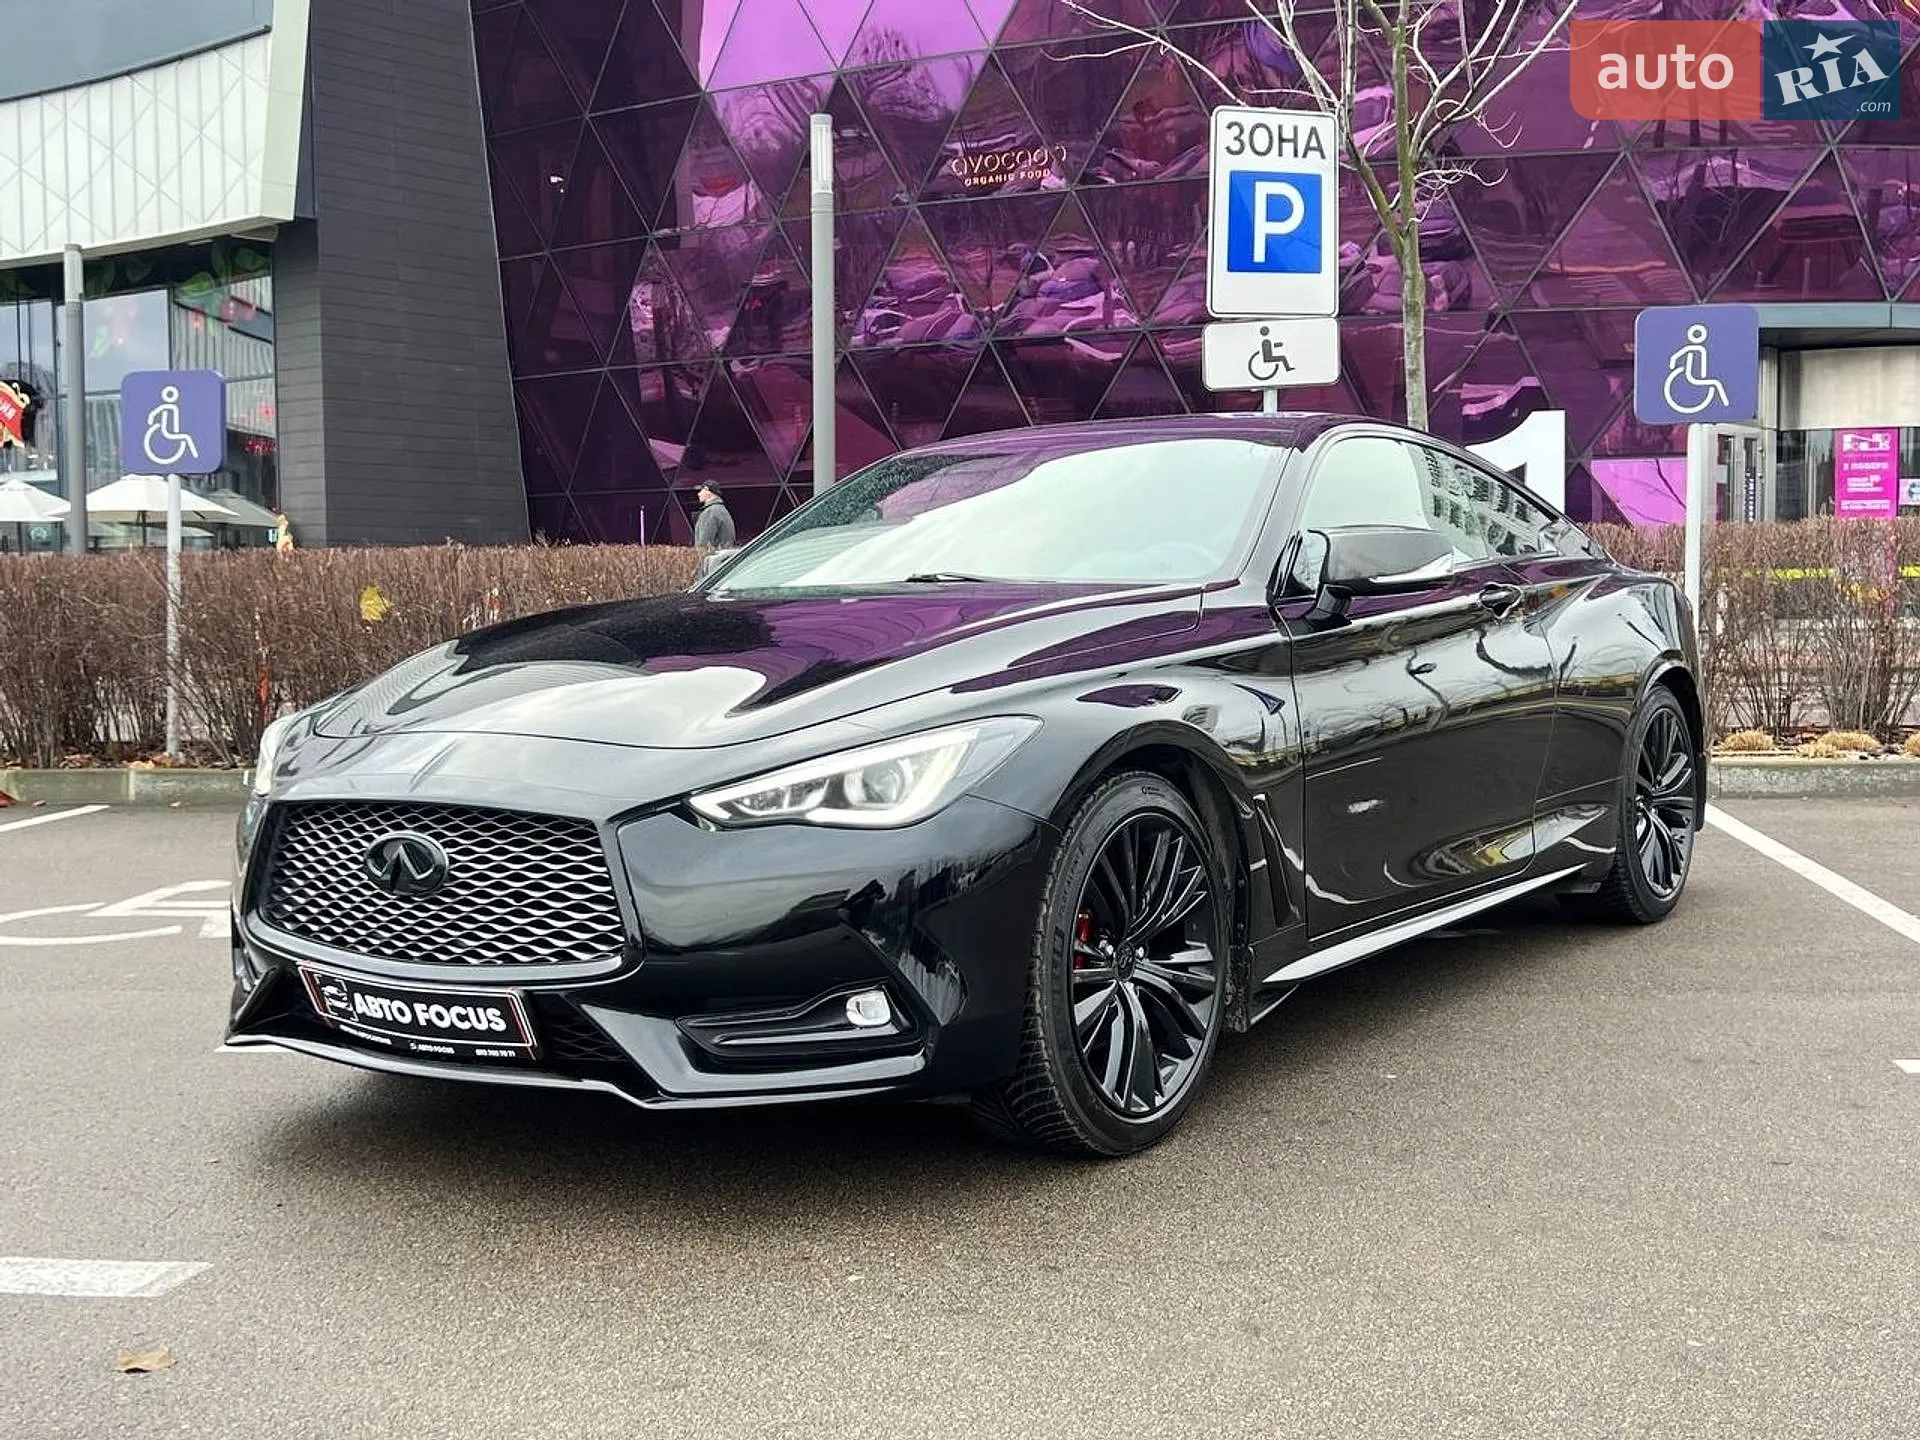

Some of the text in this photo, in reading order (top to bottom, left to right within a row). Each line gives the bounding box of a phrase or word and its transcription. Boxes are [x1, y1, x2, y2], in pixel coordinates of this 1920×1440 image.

[1225, 121, 1326, 160] ЗОНА
[1020, 168, 1050, 180] FOOD
[1253, 180, 1305, 263] P
[414, 1002, 507, 1032] FOCUS
